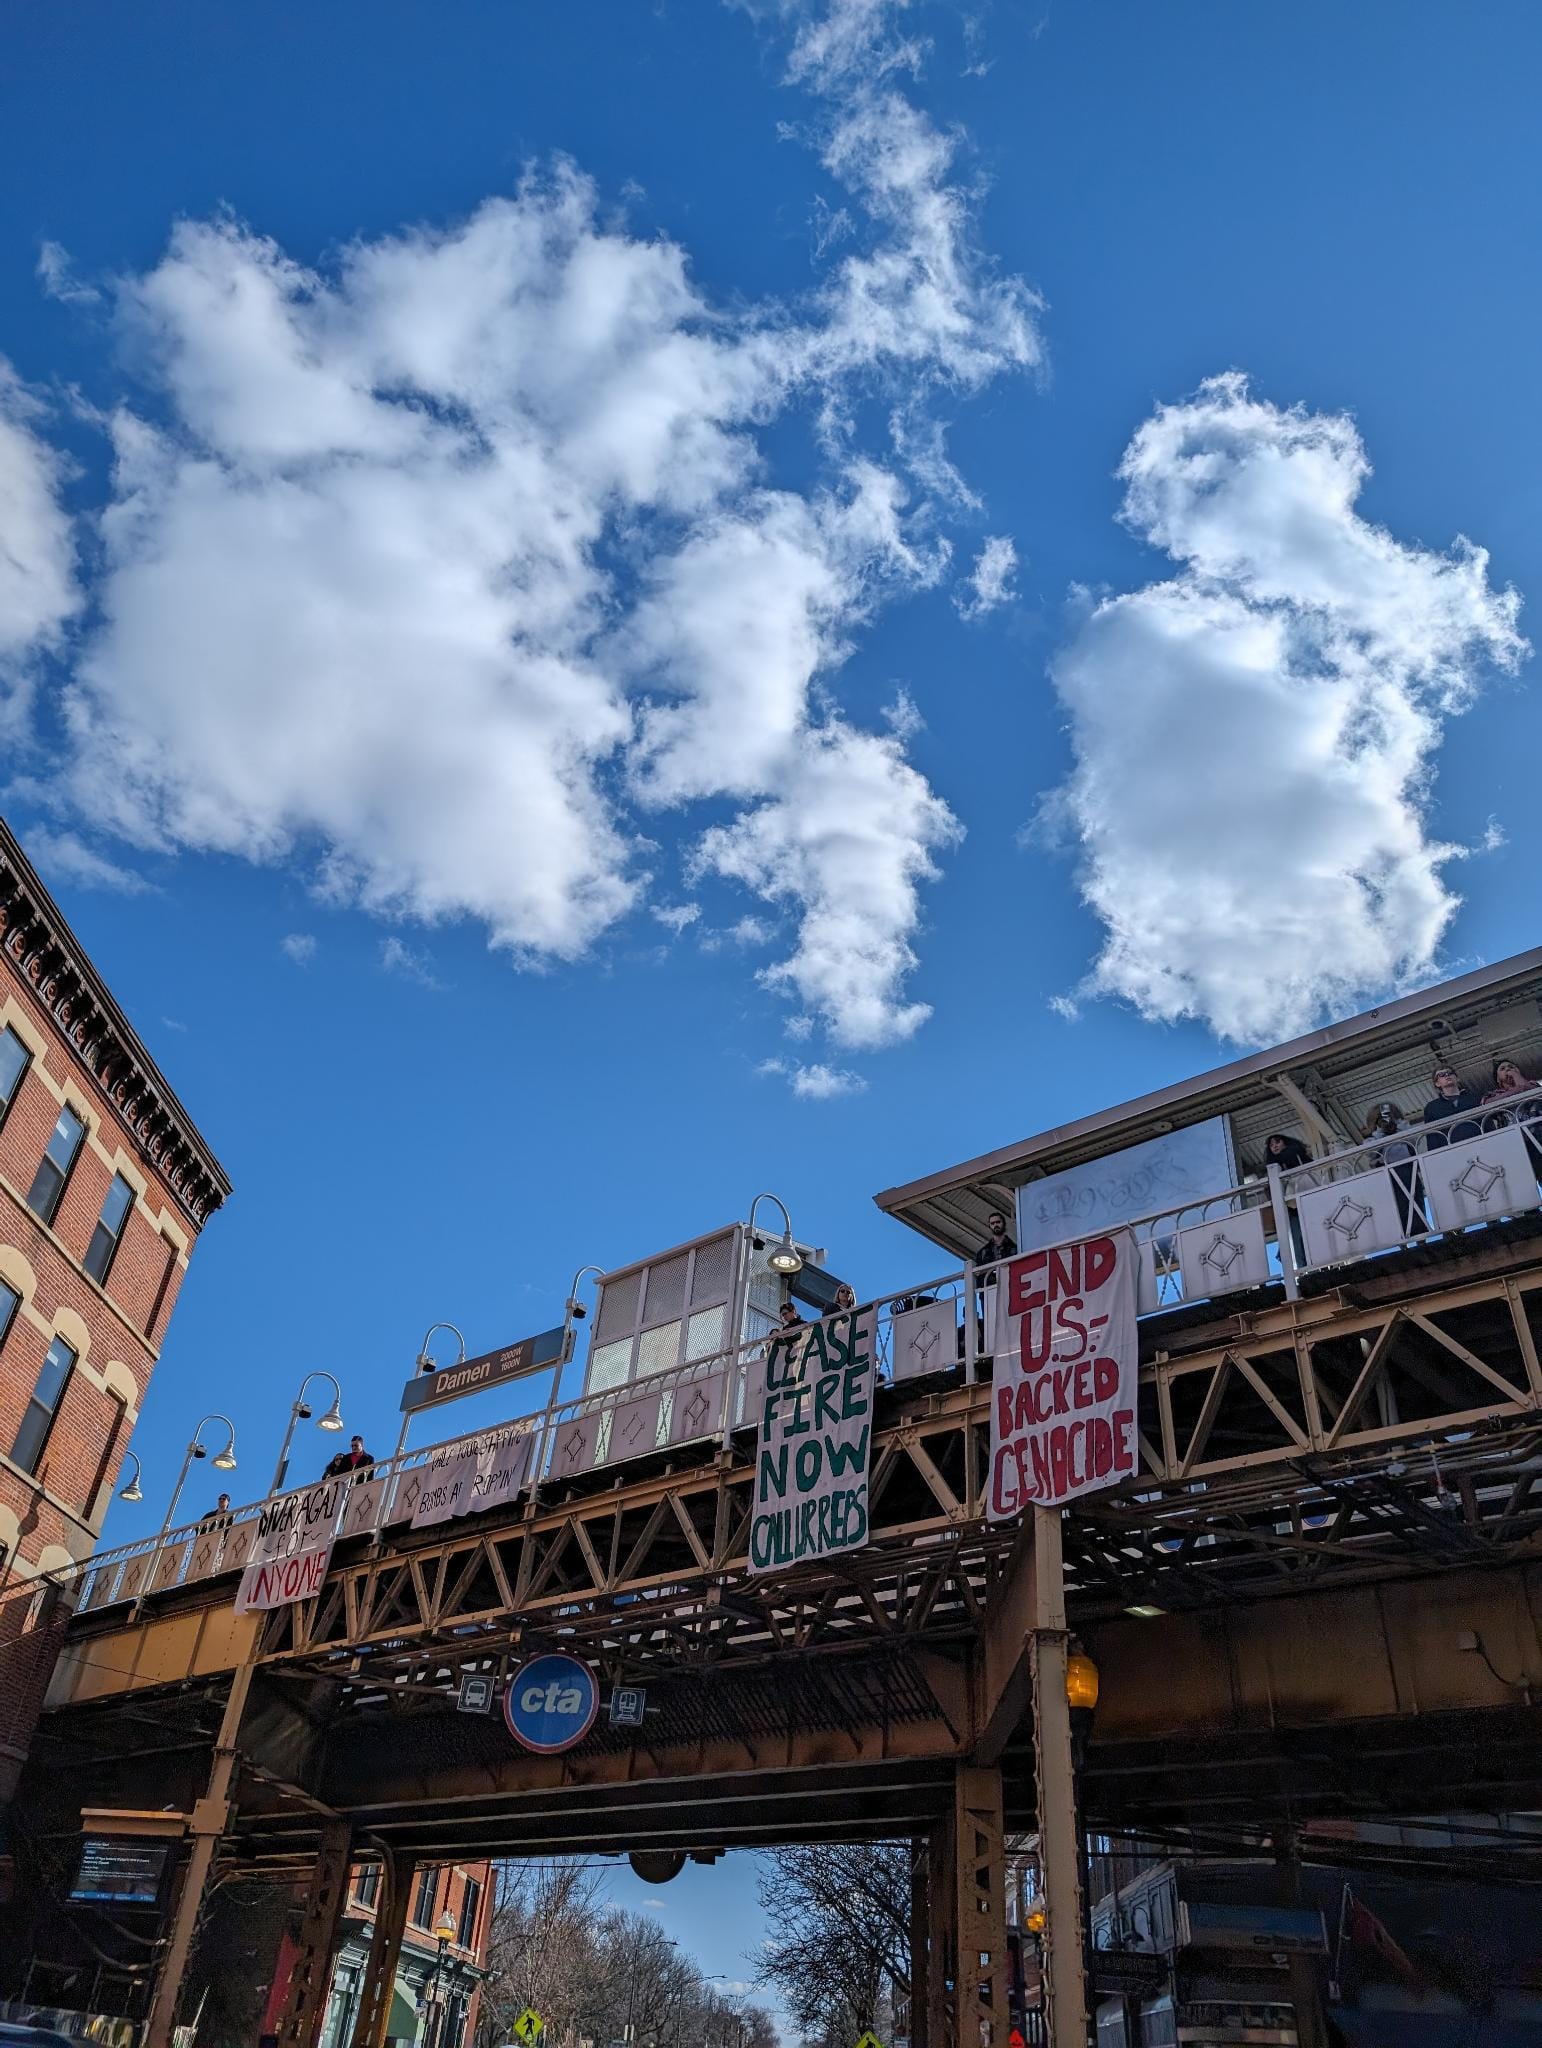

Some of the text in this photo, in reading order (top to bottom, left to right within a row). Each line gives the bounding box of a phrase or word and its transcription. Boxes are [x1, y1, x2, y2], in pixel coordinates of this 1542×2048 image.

[1008, 1237, 1117, 1316] END
[435, 1362, 491, 1393] Damen
[500, 1345, 524, 1361] 2000W
[767, 1304, 874, 1391] CEASE
[763, 1361, 870, 1442] FIRE
[998, 1357, 1120, 1440] BACKED
[760, 1424, 870, 1502] NOW
[992, 1409, 1134, 1515] GENOCIDE
[246, 1551, 327, 1604] NYONE
[520, 1682, 583, 1714] cta
